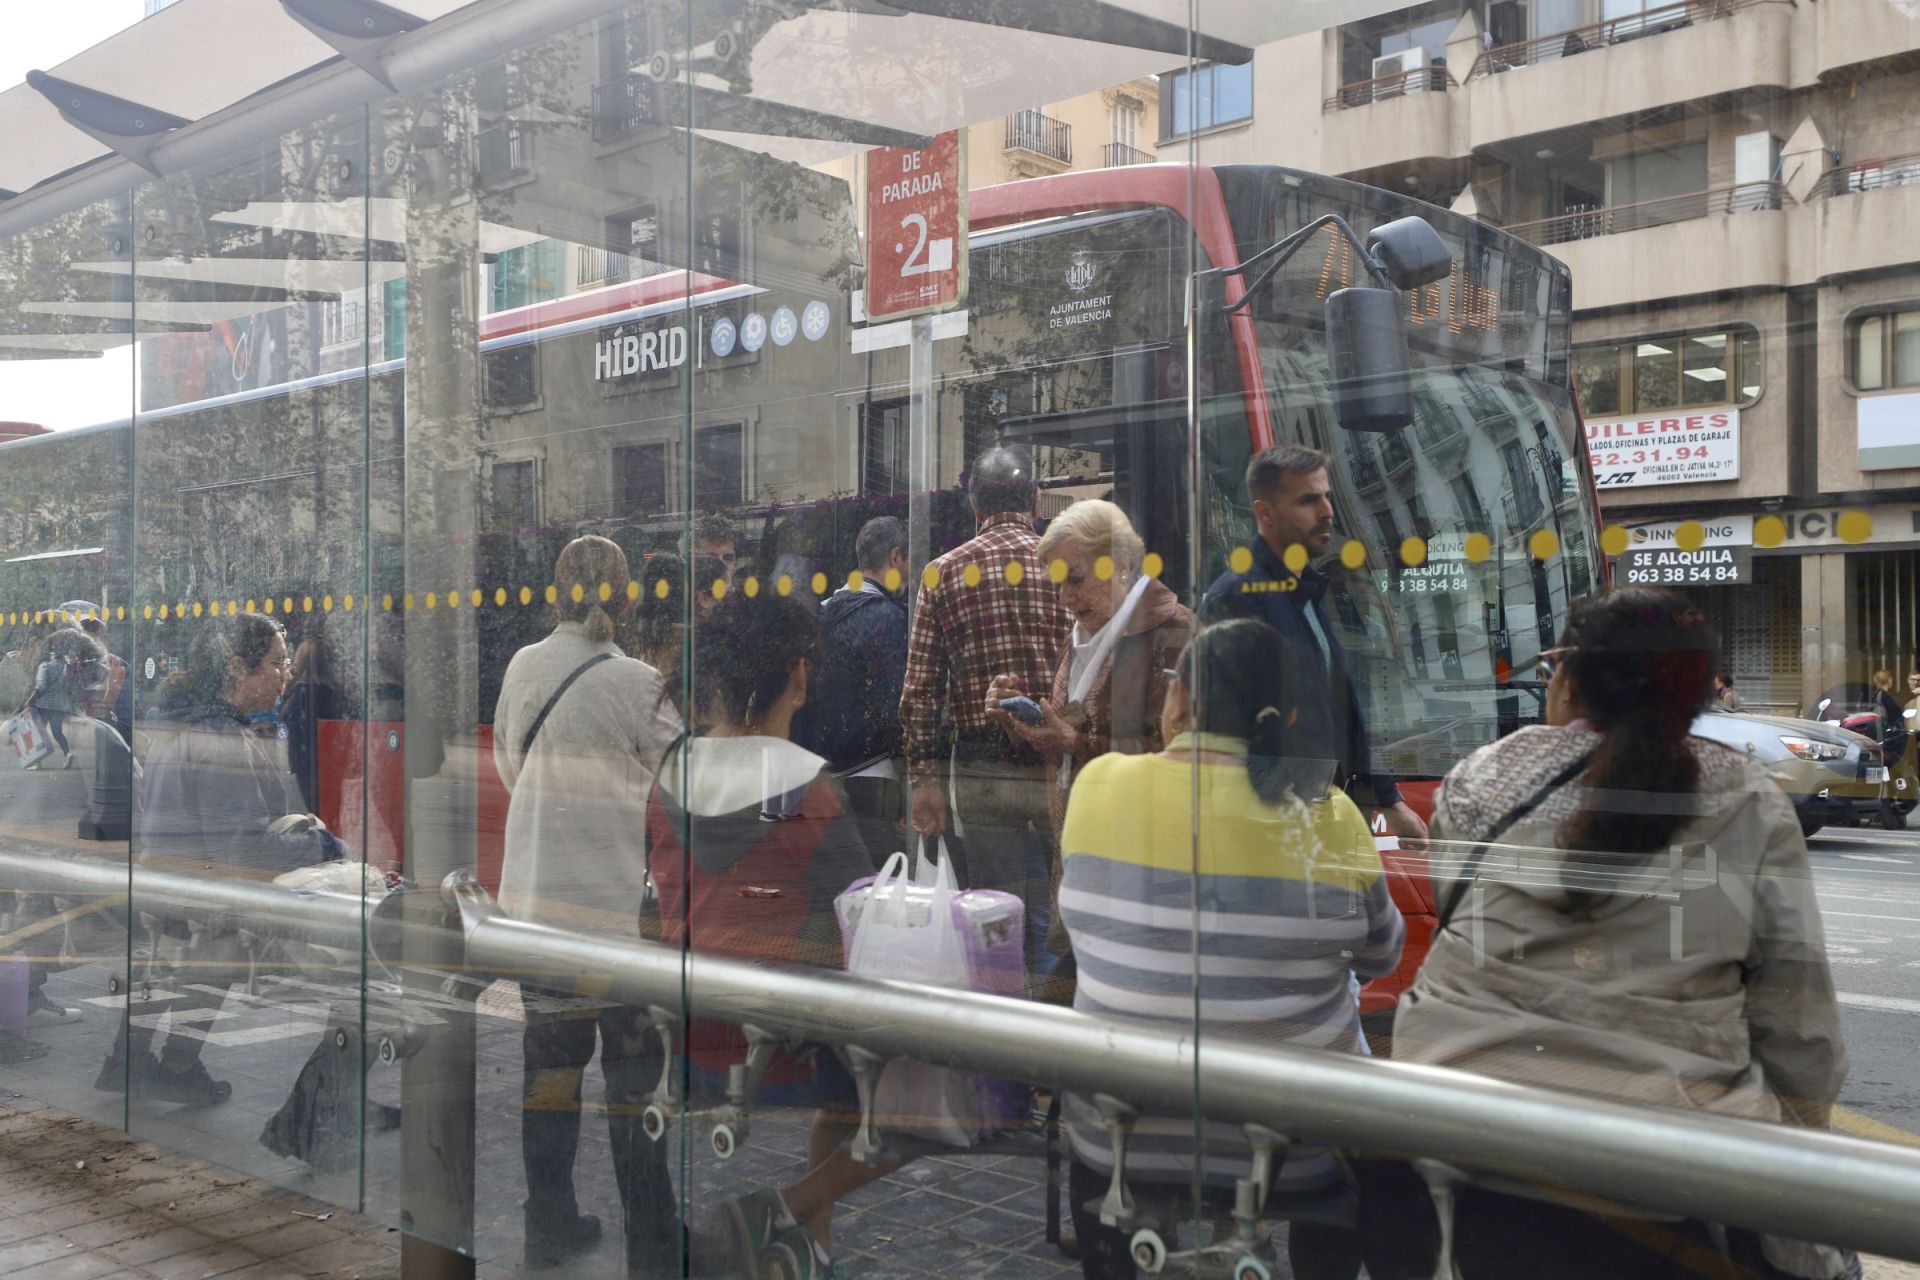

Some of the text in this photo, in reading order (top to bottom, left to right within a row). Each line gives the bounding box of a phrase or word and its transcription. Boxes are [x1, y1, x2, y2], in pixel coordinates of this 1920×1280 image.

[902, 150, 921, 173] DE
[882, 171, 943, 204] PARADA
[1049, 295, 1112, 315] AJUNTAMENT
[1049, 309, 1112, 328] DE VALENCIA
[595, 325, 688, 380] HÍBRID
[1651, 437, 1656, 446] Y
[1658, 434, 1687, 446] PLAZAS
[1688, 434, 1698, 442] DE
[1701, 430, 1731, 441] GARAJE
[1683, 471, 1717, 480] Valencia
[1650, 526, 1734, 541] INMING
[1633, 550, 1733, 567] SE ALQUILA
[1628, 566, 1739, 583] 963 38 54 84
[1409, 580, 1427, 592] 38
[1430, 579, 1448, 591] 54
[1452, 579, 1468, 590] 84
